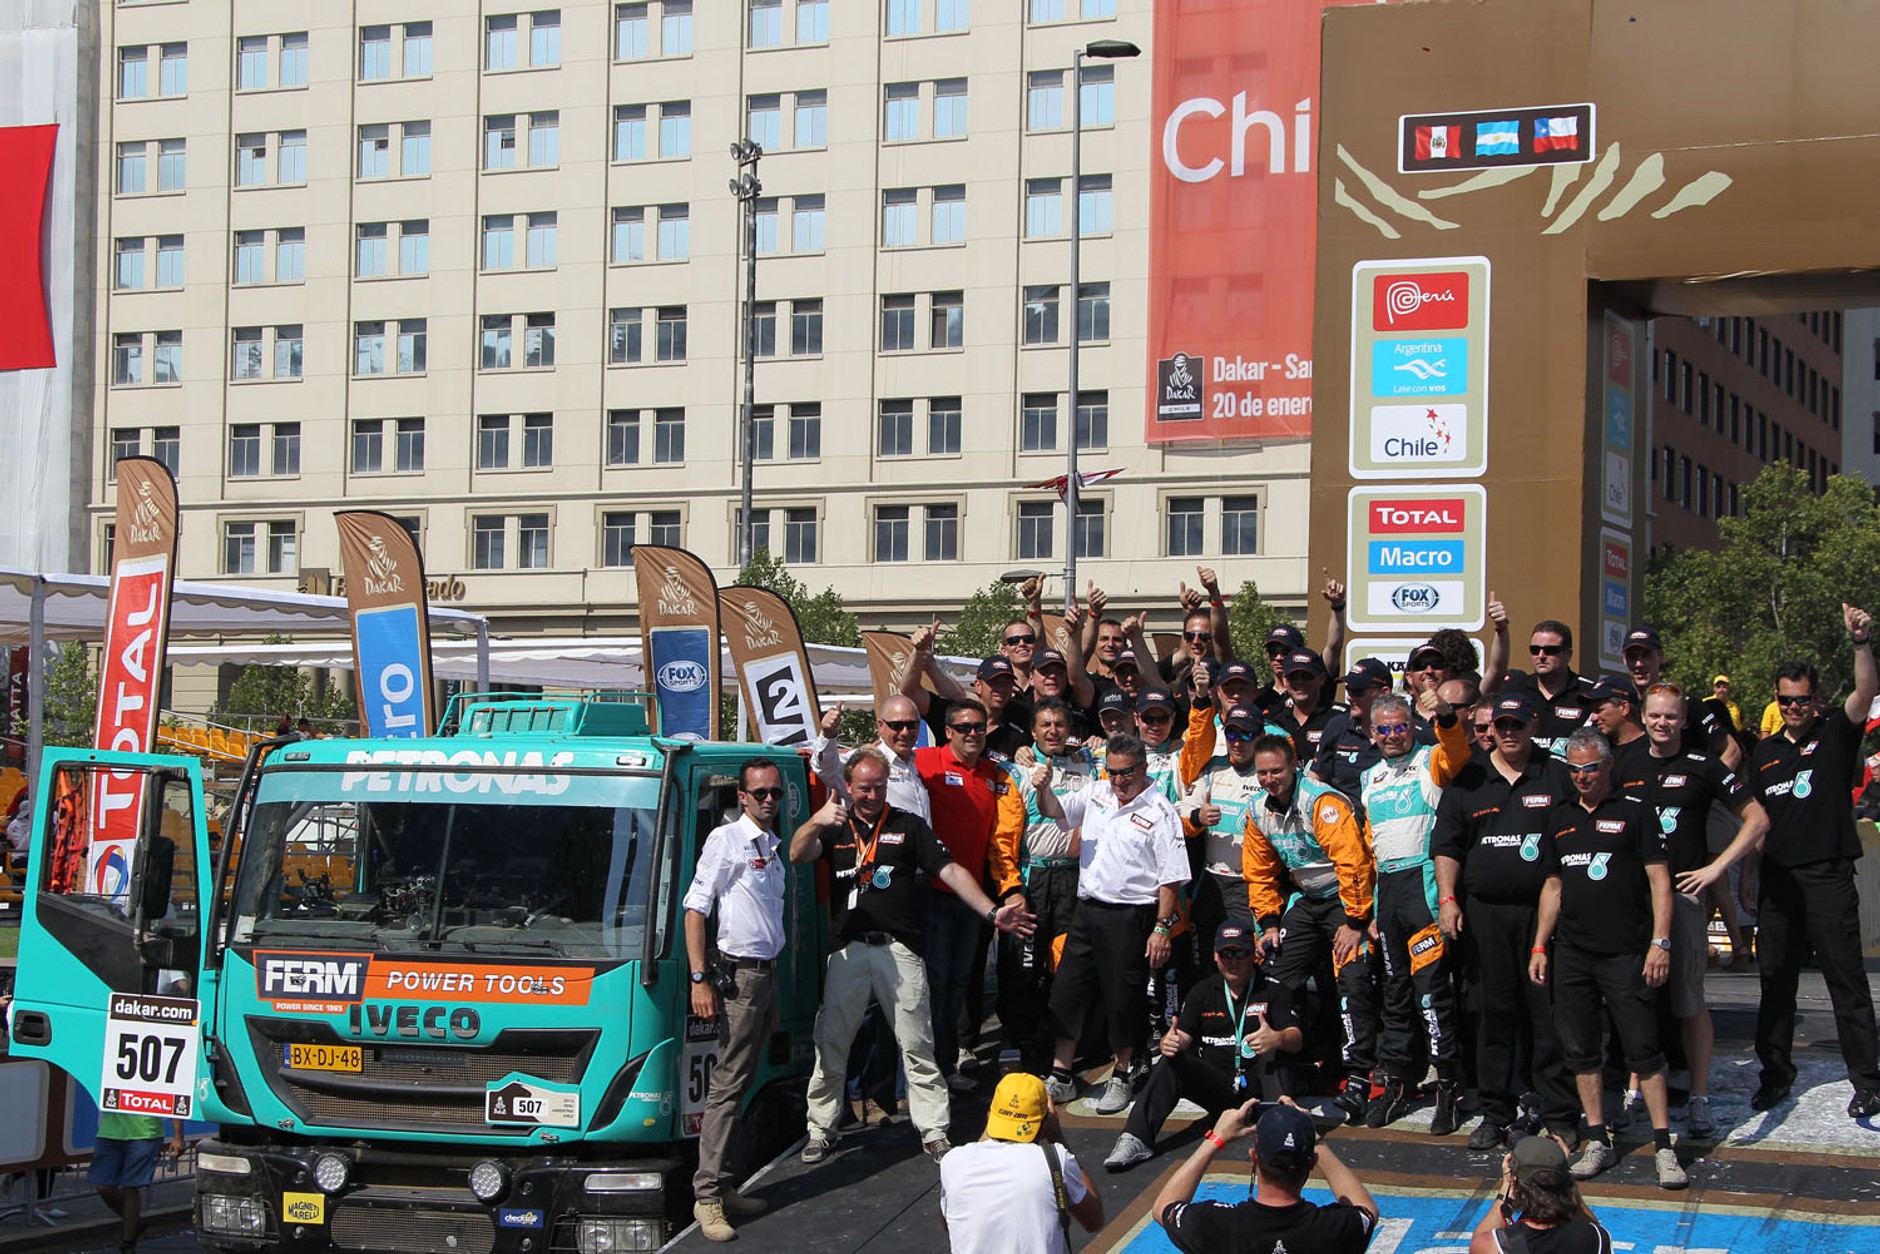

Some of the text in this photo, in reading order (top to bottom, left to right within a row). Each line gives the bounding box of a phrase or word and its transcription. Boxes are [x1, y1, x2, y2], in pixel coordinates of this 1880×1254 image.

[1386, 281, 1455, 324] Perú
[1394, 343, 1443, 357] Argentina
[1213, 355, 1268, 382] Dakar
[1166, 385, 1196, 400] DAKAR
[1429, 384, 1446, 392] vos
[1213, 391, 1312, 418] 20 de ener
[1385, 437, 1438, 458] Chile
[1376, 507, 1457, 525] TOTAL
[131, 521, 161, 544] DAKAR
[1380, 548, 1452, 566] Macro
[364, 574, 404, 596] DAKAR
[1402, 588, 1429, 601] FOX
[658, 600, 698, 616] DAKAR
[745, 630, 783, 650] DAKAR
[669, 667, 697, 680] FOX
[99, 583, 157, 829] TOTAL
[380, 663, 416, 738] ro
[341, 750, 575, 795] PETRONAS
[1525, 796, 1548, 804] FERM
[264, 959, 358, 995] FERM
[387, 970, 566, 996] POWER TOOLS
[115, 999, 192, 1020] dakar.com
[276, 1002, 301, 1010] POWER
[303, 1003, 324, 1011] SINCE
[350, 1004, 481, 1039] IVECO
[116, 1033, 186, 1084] 507
[293, 1047, 360, 1067] BX-DJ-48
[122, 1093, 172, 1111] TOTAL
[518, 1099, 543, 1113] 507
[288, 1201, 319, 1213] MAGNETI
